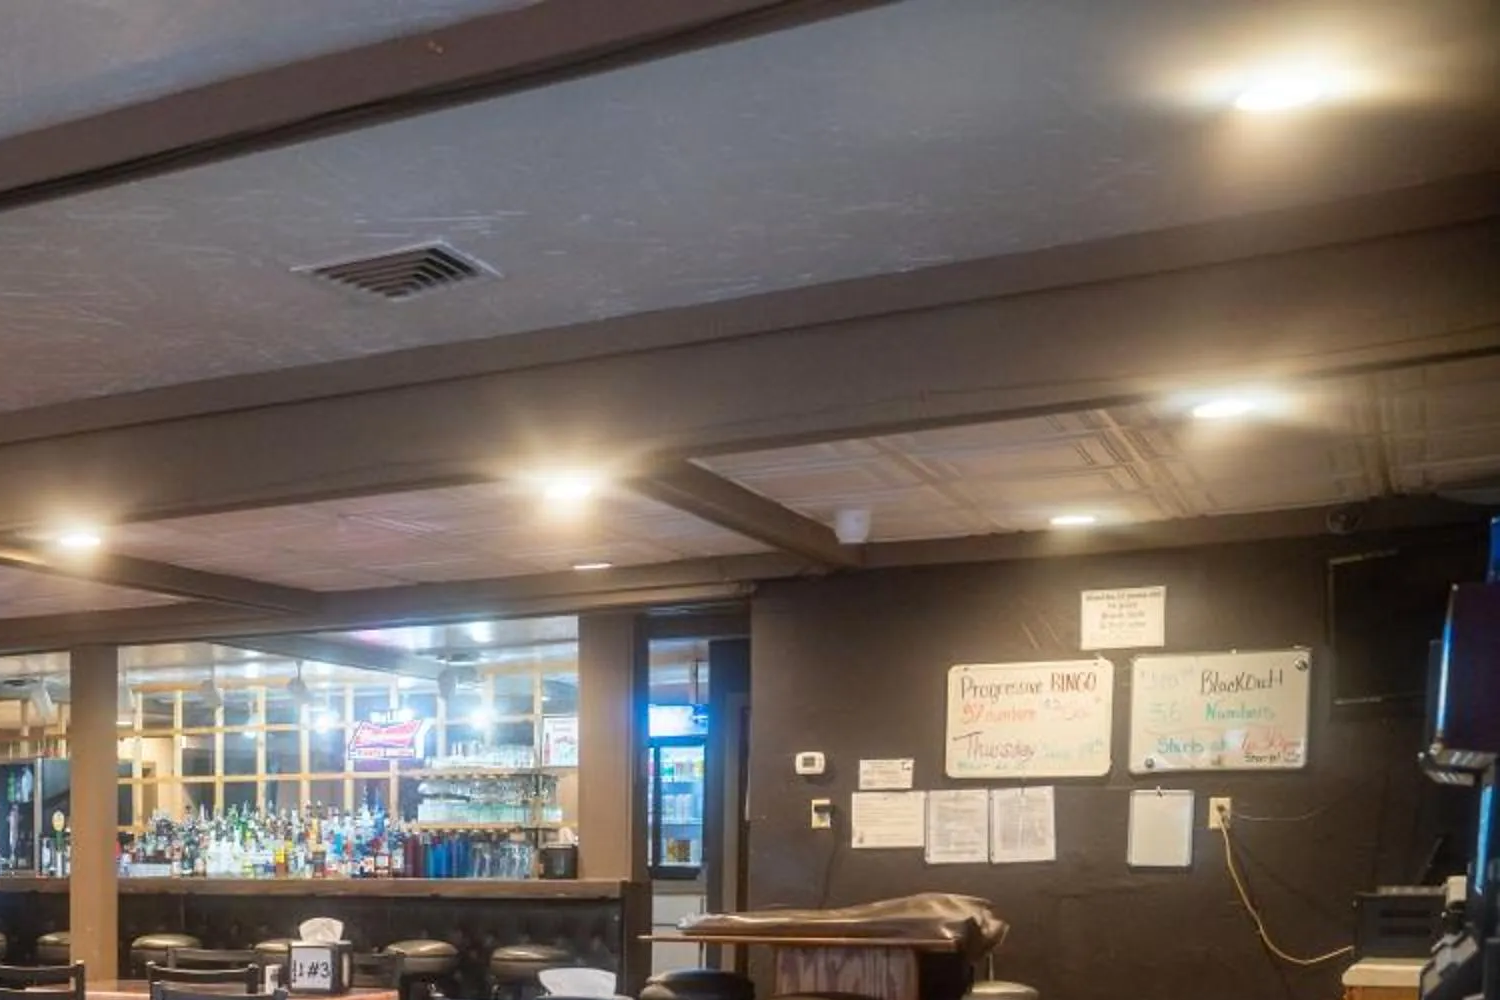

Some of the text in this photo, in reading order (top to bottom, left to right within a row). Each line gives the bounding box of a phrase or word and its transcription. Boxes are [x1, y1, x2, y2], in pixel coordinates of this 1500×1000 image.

[961, 671, 1097, 704] Progressive BINGO
[307, 961, 332, 979] #3
